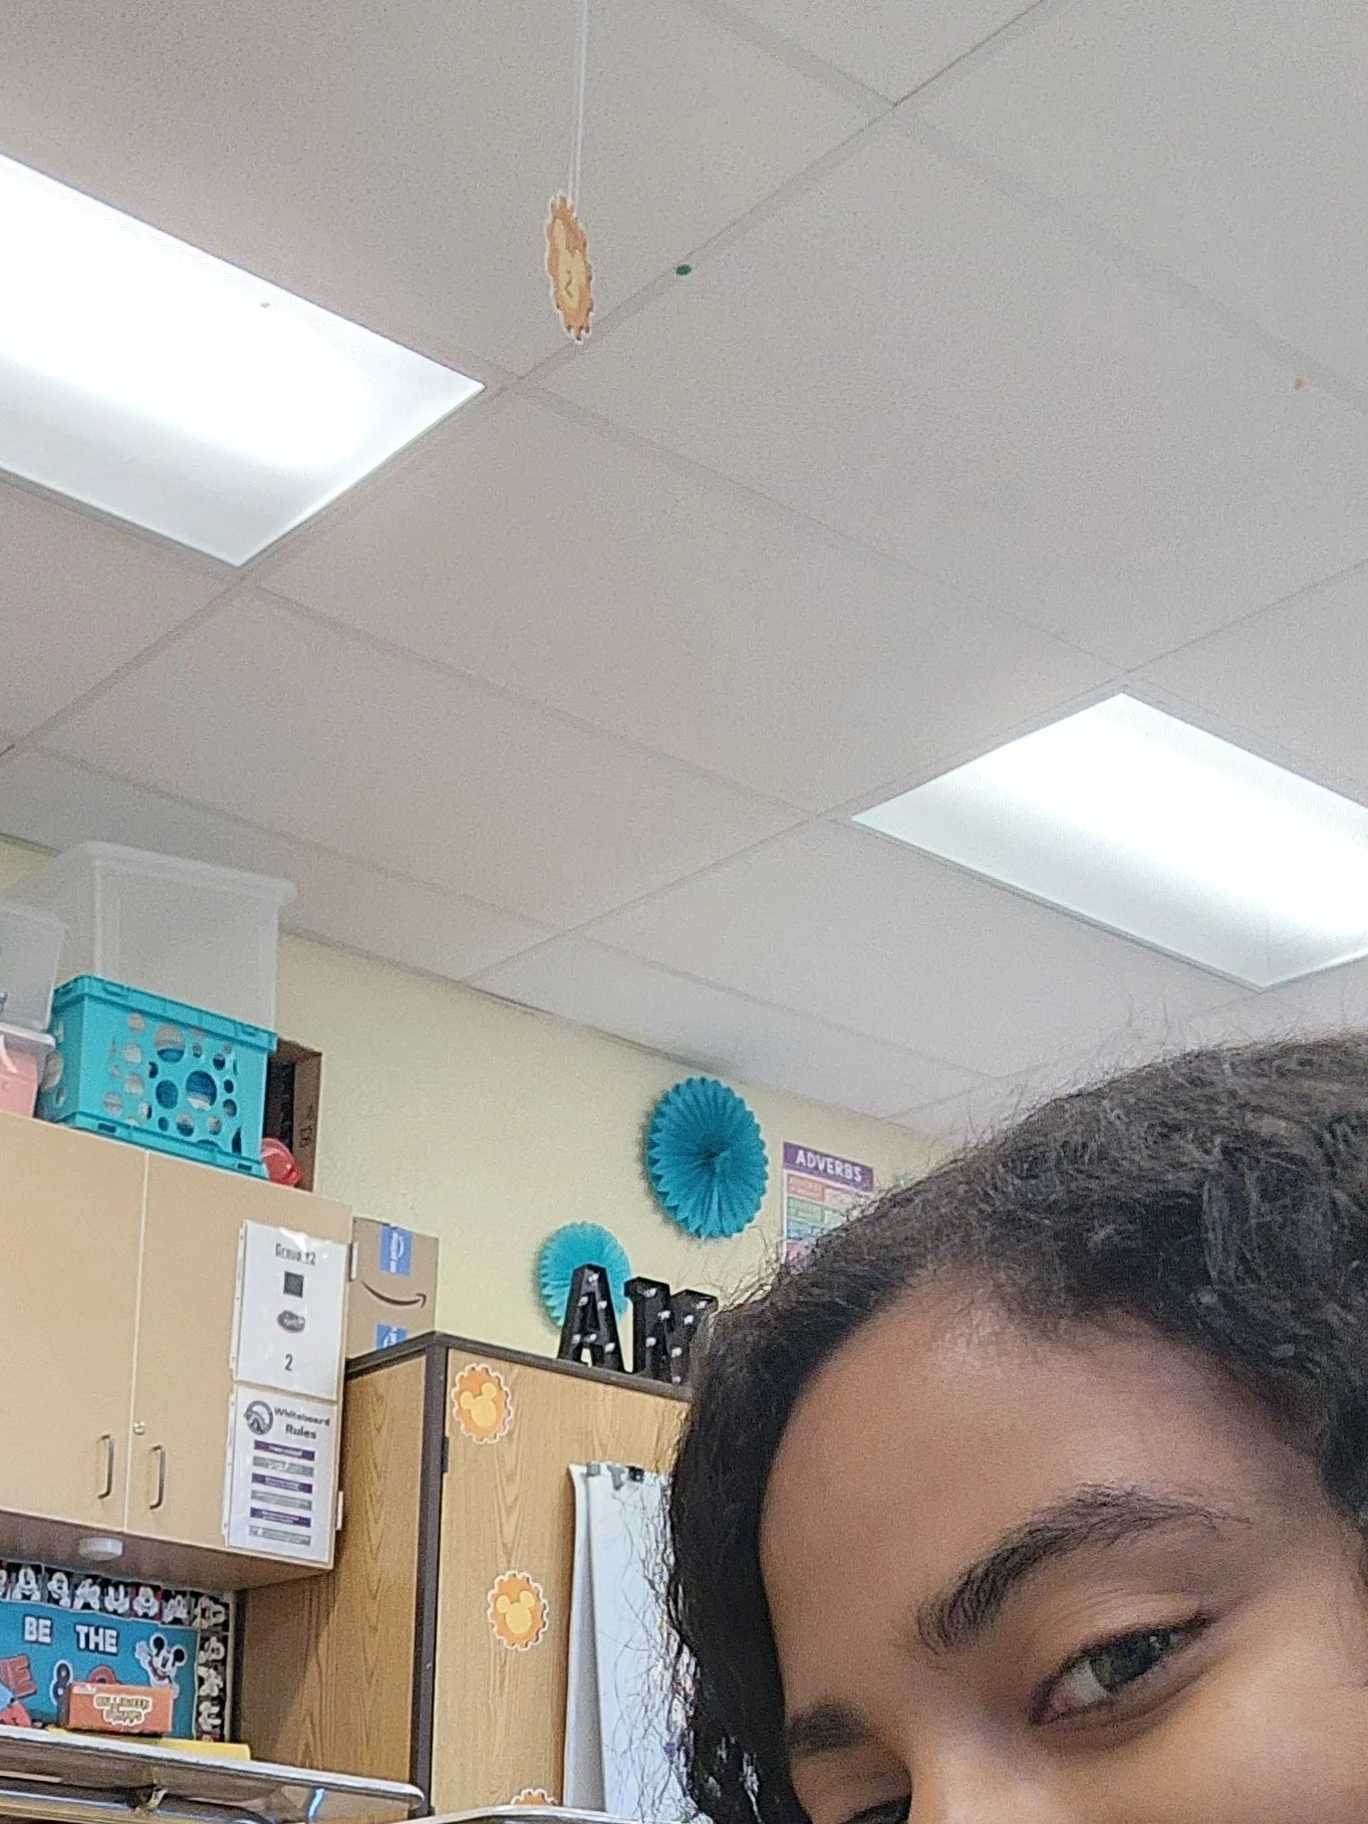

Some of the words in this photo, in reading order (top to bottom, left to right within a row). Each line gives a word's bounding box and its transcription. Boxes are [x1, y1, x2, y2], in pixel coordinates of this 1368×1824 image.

[795, 1149, 863, 1183] ADVERBS
[284, 1353, 294, 1372] 2
[274, 1406, 331, 1428] Whiteboard
[285, 1422, 317, 1440] Rules
[23, 1614, 52, 1644] BE
[75, 1623, 118, 1655] THE
